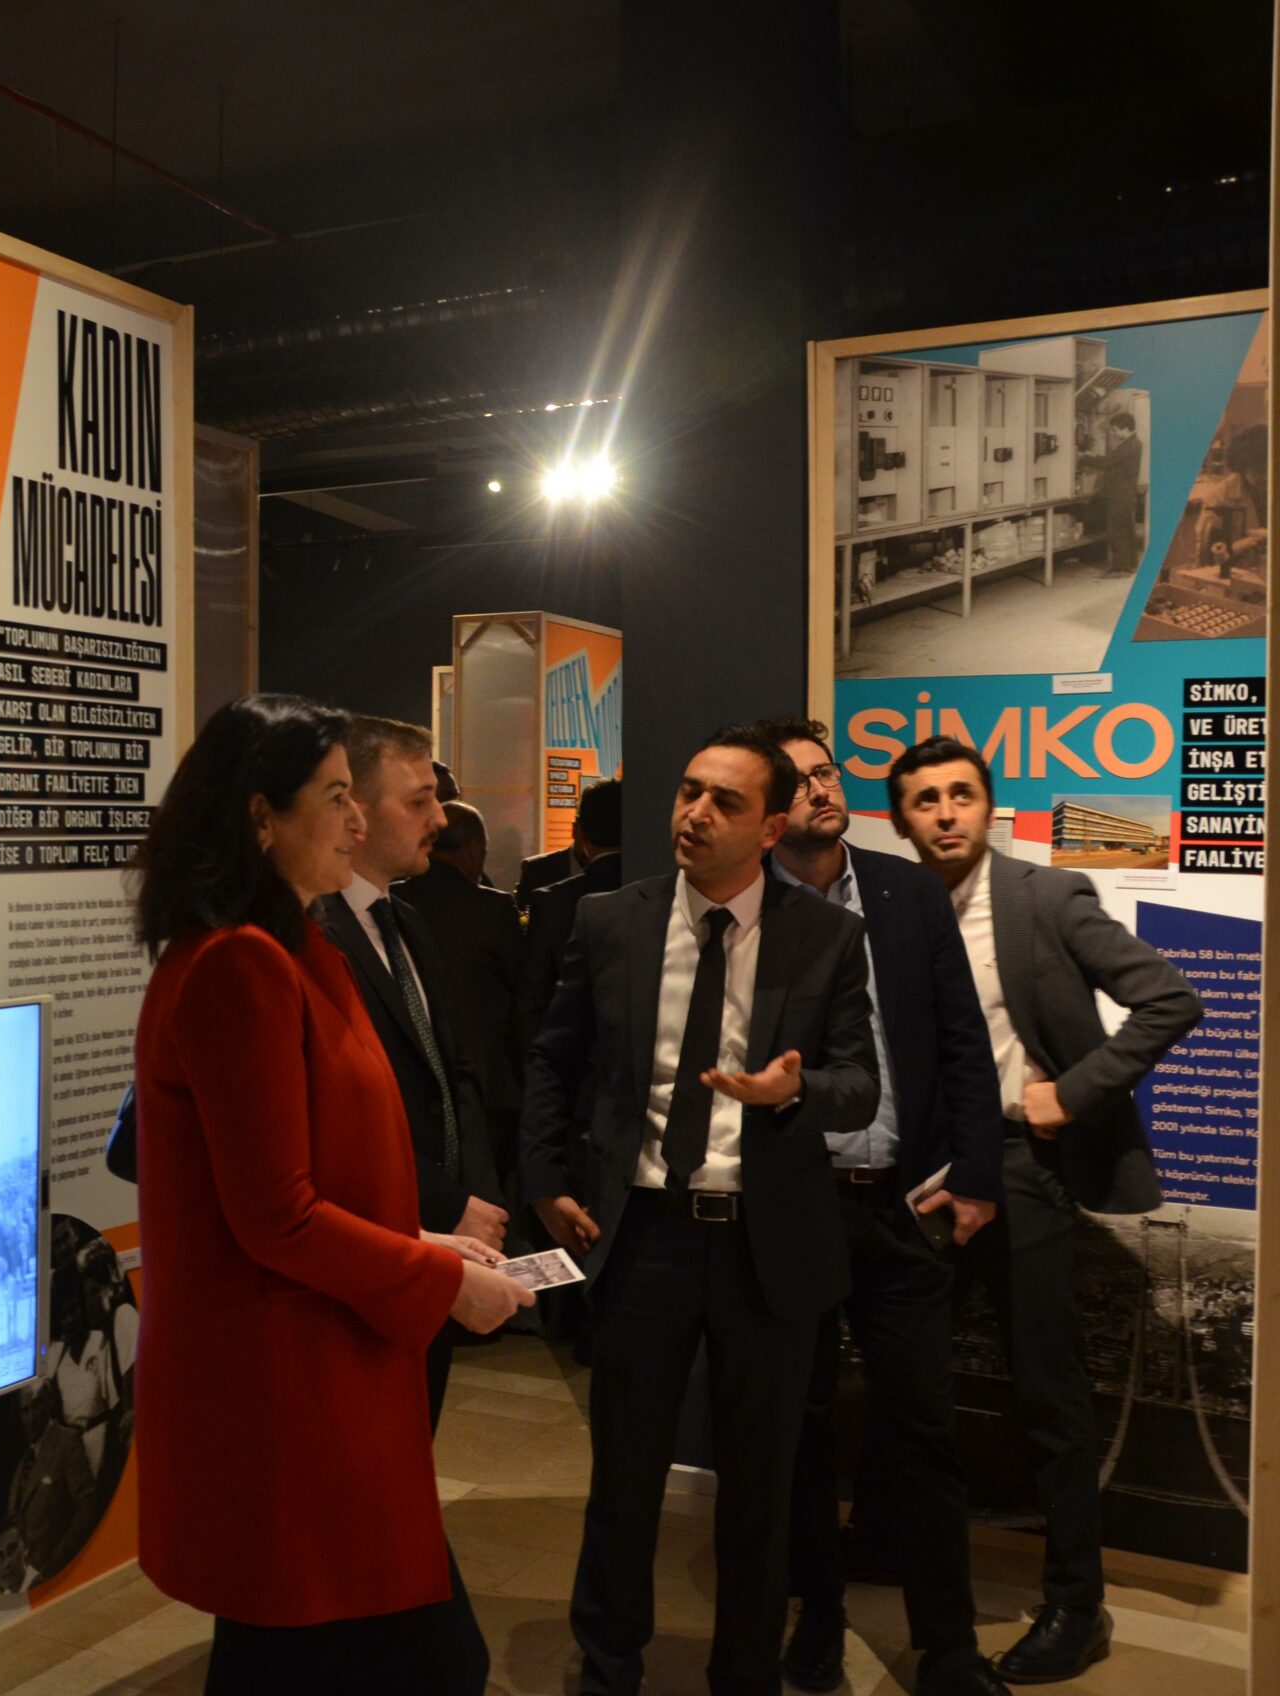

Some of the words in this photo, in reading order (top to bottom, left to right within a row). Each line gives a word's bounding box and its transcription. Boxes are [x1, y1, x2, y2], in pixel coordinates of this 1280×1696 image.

[57, 309, 161, 493] KADIN
[11, 473, 162, 628] MÜCADELESİ
[64, 635, 161, 665] BAŞARISIZLIĞININ
[32, 666, 71, 687] SEBEBİ
[76, 671, 132, 693] KADINLARA
[1189, 681, 1258, 703] SİMKO,
[39, 703, 66, 722] OLAN
[71, 703, 156, 729] BİLGİSİZLİKTEN
[1189, 718, 1213, 735] VE
[44, 736, 65, 756] BİR
[70, 740, 120, 760] TOPLUMUN
[125, 741, 144, 761] BİR
[1188, 748, 1235, 773] İNŞA
[45, 772, 109, 794] FAALİYETTE
[114, 774, 139, 794] İKEN
[39, 807, 59, 827] BİR
[65, 811, 102, 827] ORGANI
[108, 808, 150, 832] İŞLEMEZ
[26, 847, 33, 864] O
[39, 846, 79, 864] TOPLUM
[84, 846, 109, 867] FELÇ
[1185, 848, 1265, 868] FAALİYE
[1199, 950, 1213, 960] 58
[1216, 950, 1234, 960] bin
[1185, 970, 1217, 979] sonra
[1220, 970, 1235, 980] bu
[1201, 988, 1228, 999] akım
[1231, 992, 1245, 1000] ve
[1206, 1028, 1241, 1040] büyük
[1190, 1048, 1232, 1058] yatırımı
[1197, 1066, 1242, 1078] kurulan,
[1152, 1084, 1211, 1097] geliştirdiği
[1152, 1102, 1202, 1114] gösteren
[1204, 1105, 1242, 1118] Simko,
[1151, 1120, 1178, 1131] 2001
[1180, 1123, 1217, 1135] yılında
[1219, 1126, 1243, 1136] tüm
[1152, 1148, 1176, 1159] Tüm
[1179, 1151, 1194, 1161] bu
[1196, 1154, 1250, 1166] yatırımlar
[1165, 1169, 1220, 1182] köprünün
